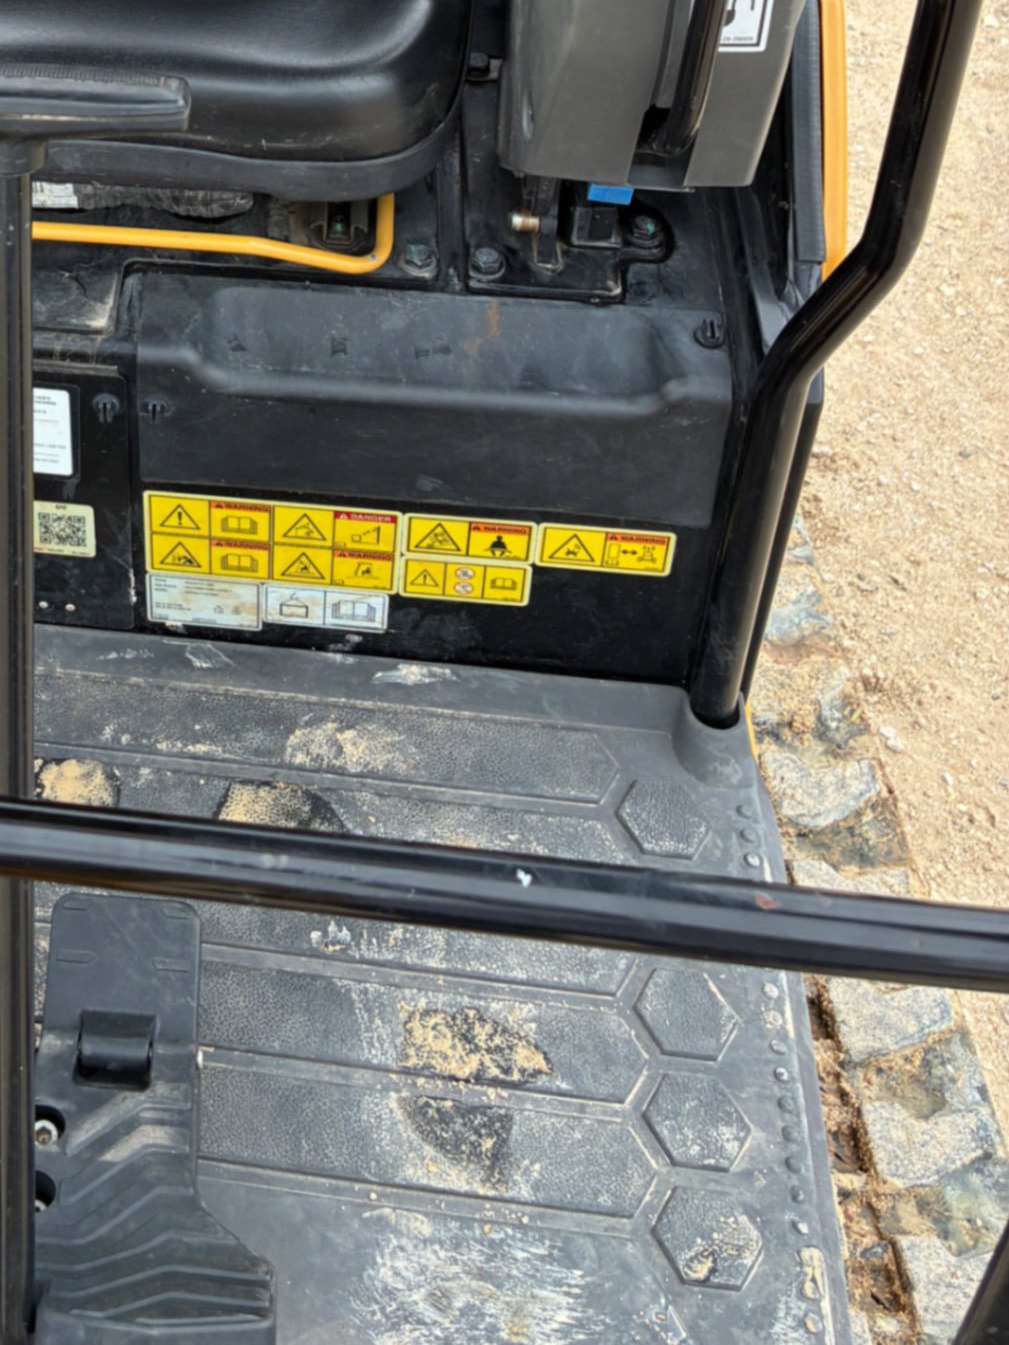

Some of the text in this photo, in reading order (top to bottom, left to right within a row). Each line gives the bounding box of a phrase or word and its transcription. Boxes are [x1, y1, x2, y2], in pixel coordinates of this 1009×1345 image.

[225, 502, 270, 512] WARNING
[351, 513, 391, 522] DANGER
[483, 525, 528, 535] WARNING
[621, 535, 667, 545] WARNING
[225, 541, 270, 551] WARNING
